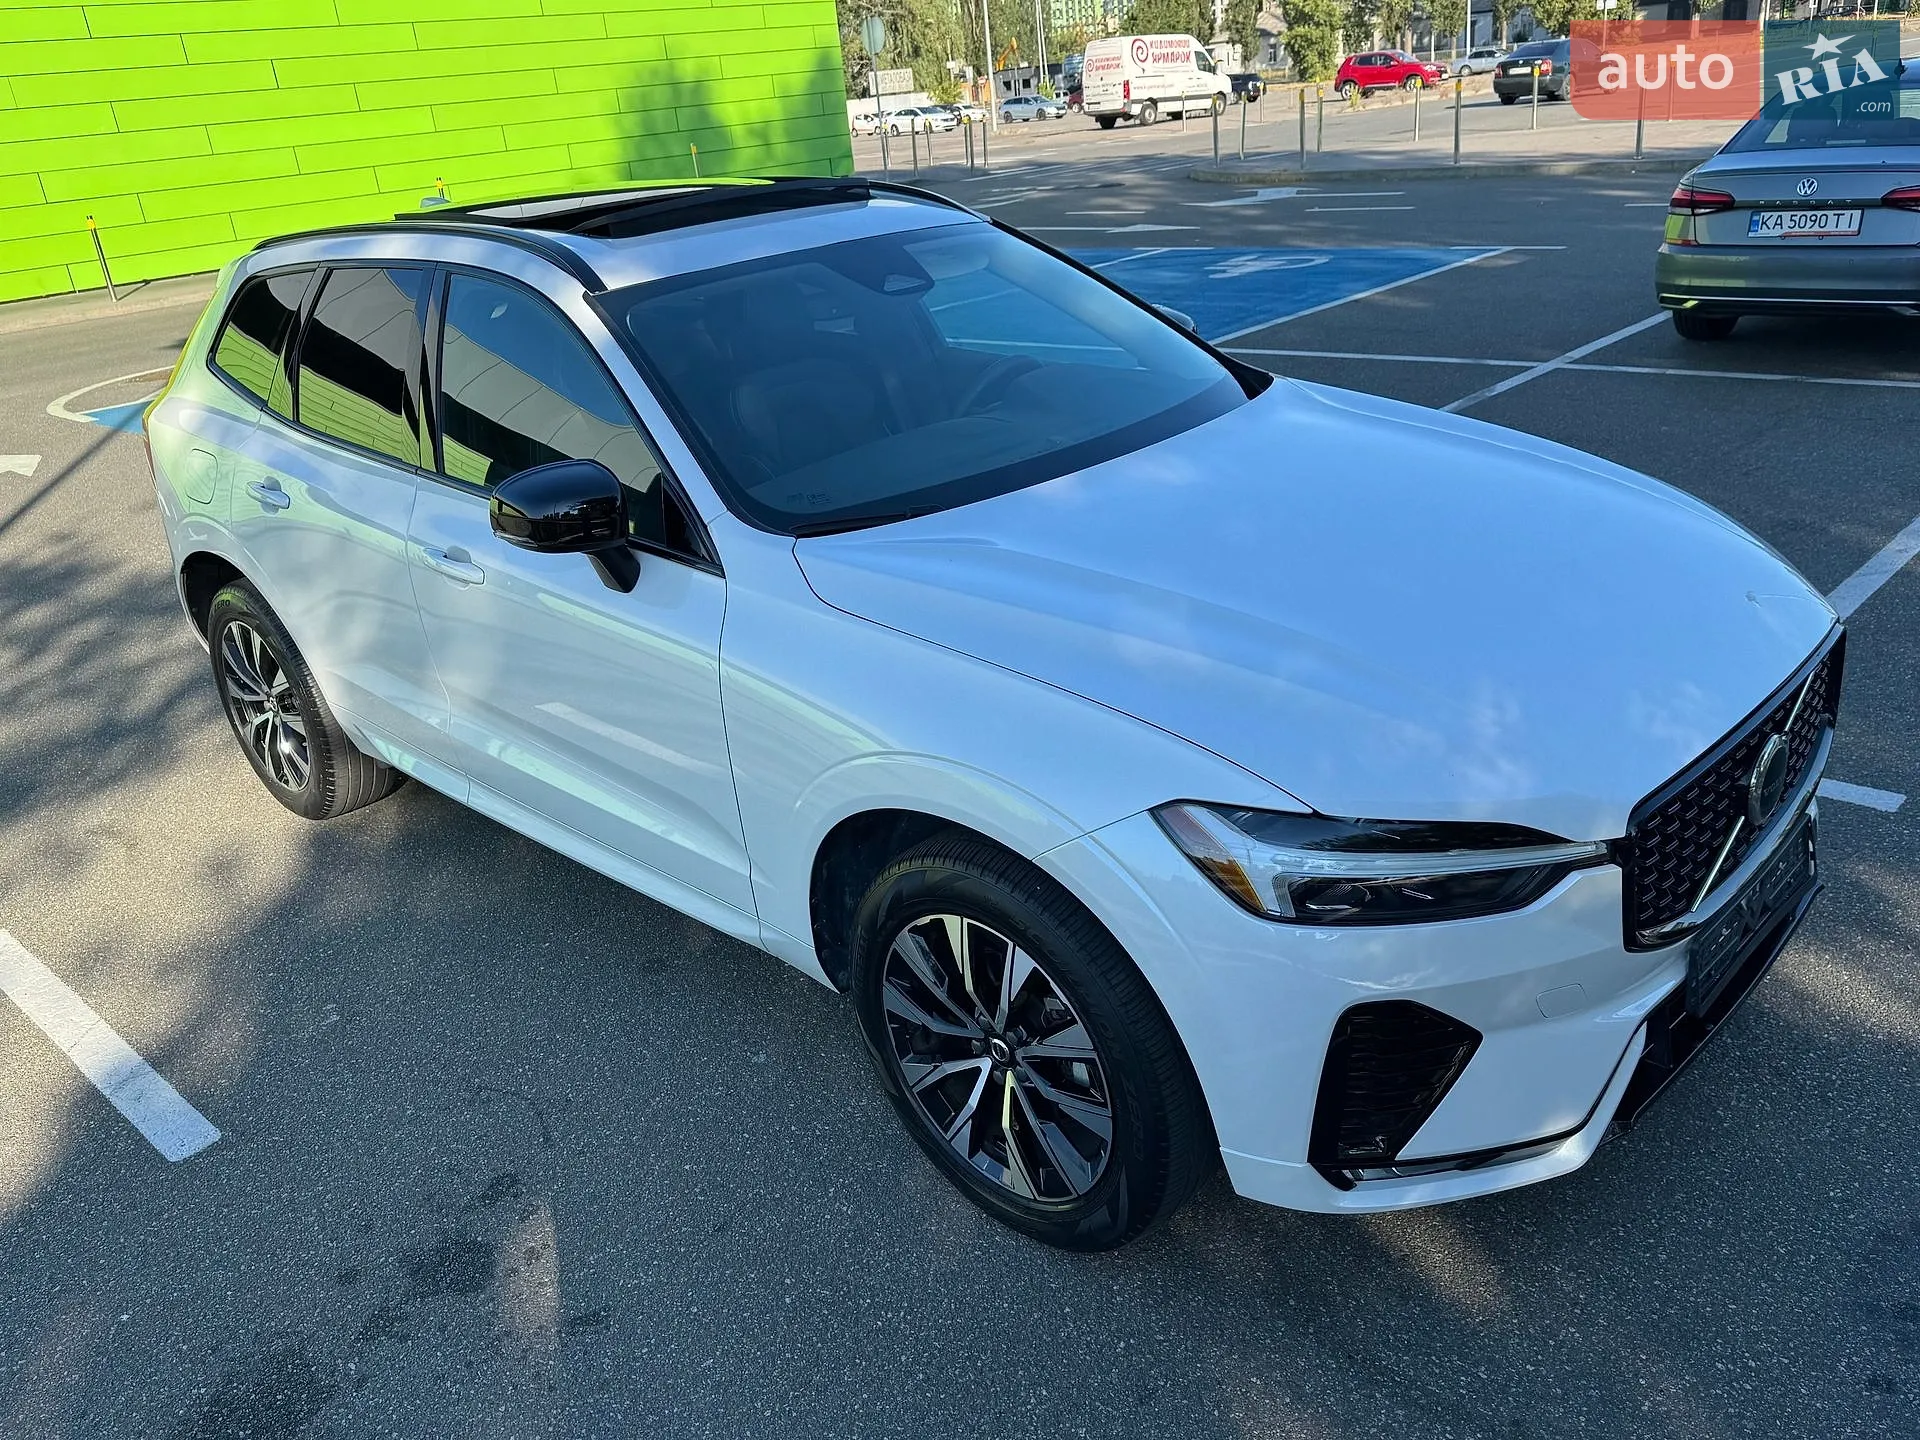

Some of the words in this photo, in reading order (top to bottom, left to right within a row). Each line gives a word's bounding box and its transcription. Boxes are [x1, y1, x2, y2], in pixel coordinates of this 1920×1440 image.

[1152, 50, 1191, 64] ЯРМАРОК
[1760, 214, 1783, 230] KA
[1787, 213, 1828, 229] 5090
[1833, 212, 1854, 229] TI
